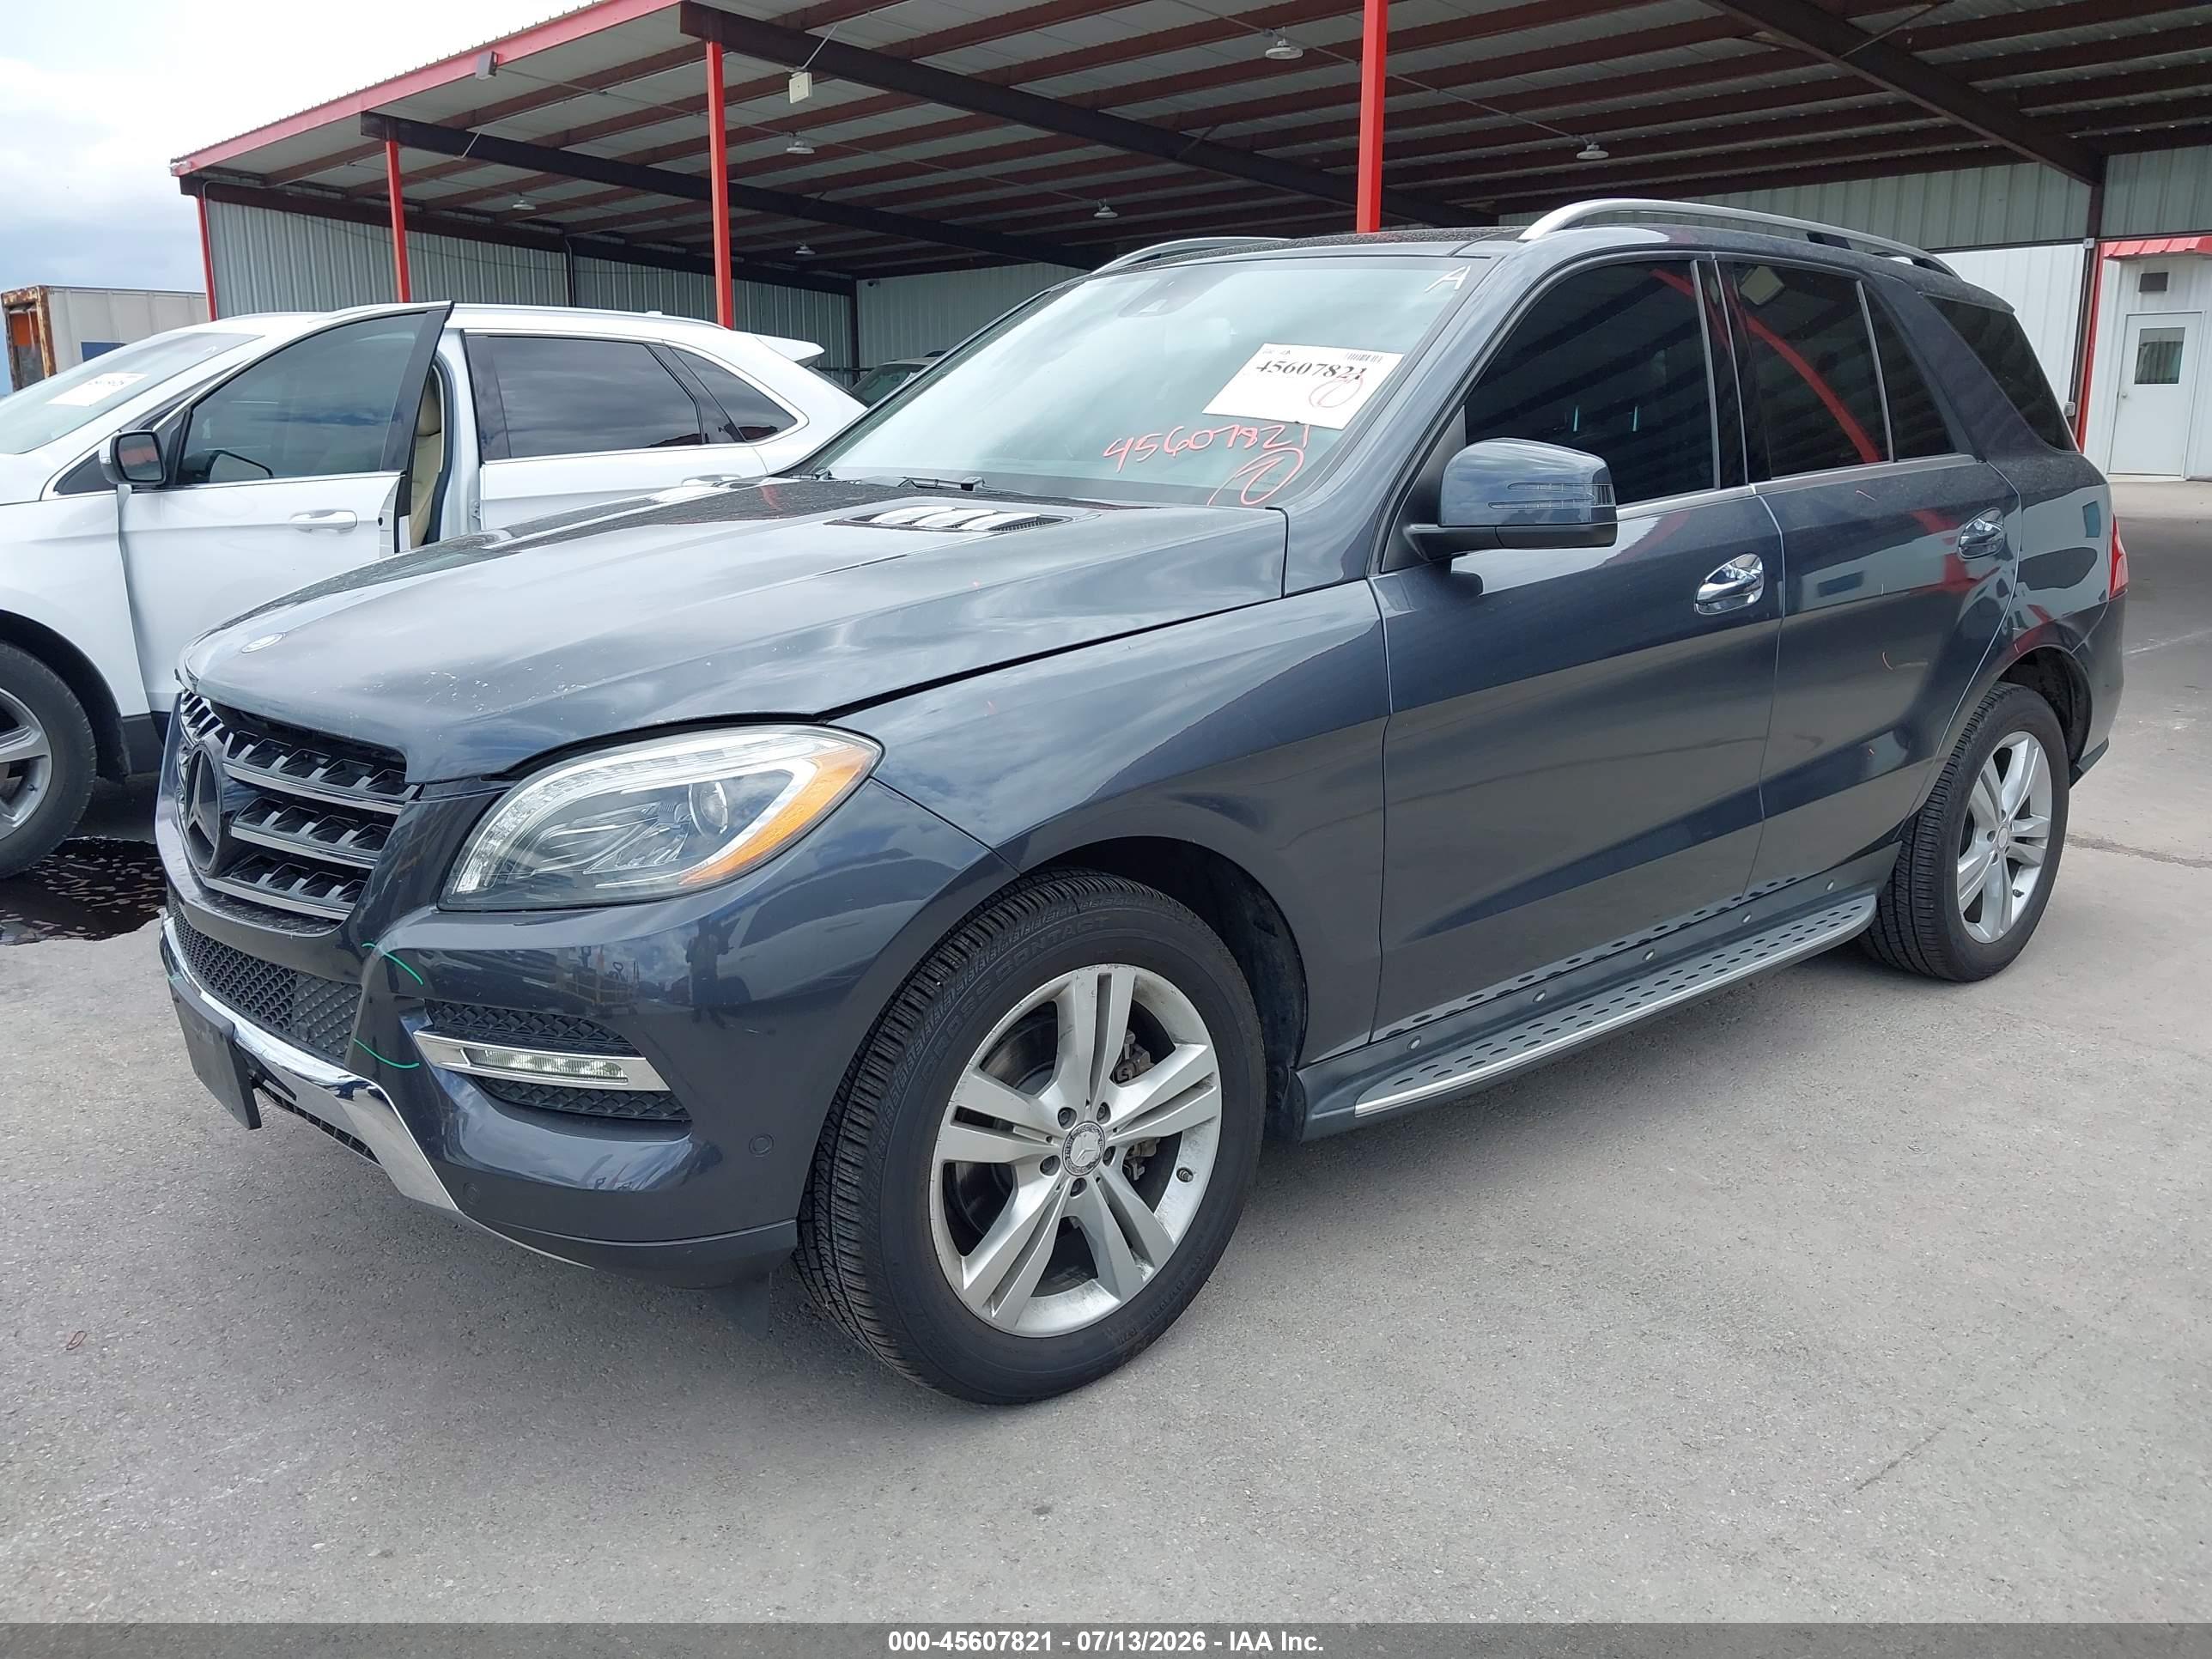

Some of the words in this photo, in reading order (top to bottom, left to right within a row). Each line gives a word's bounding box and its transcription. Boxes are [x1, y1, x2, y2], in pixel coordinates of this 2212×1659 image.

[1425, 264, 1471, 292] A
[1256, 360, 1367, 380] 45607821
[1103, 424, 1310, 473] 45607821
